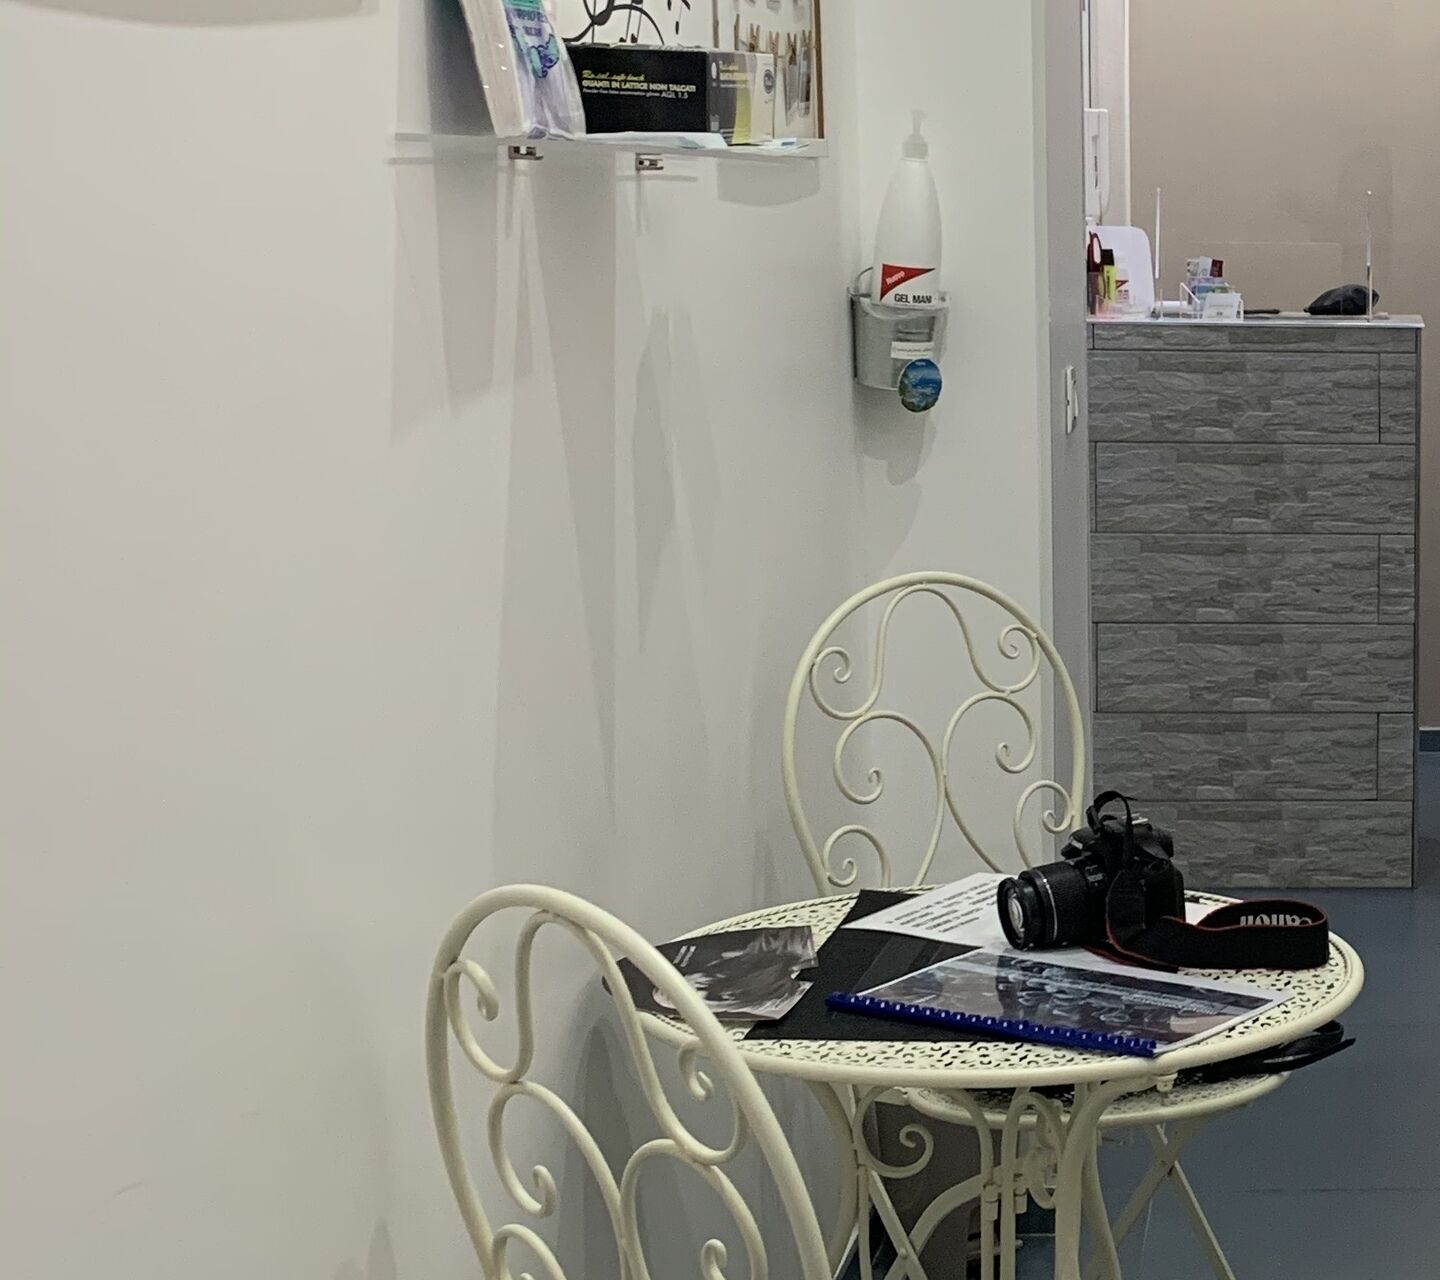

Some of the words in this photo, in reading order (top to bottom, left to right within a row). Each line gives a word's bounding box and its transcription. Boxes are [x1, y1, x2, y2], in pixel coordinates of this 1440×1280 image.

[582, 80, 610, 88] GUANTI
[611, 81, 620, 89] IN
[621, 81, 648, 90] LATTICE
[649, 83, 667, 91] NON
[669, 84, 697, 93] TALCATI
[661, 91, 676, 99] AQL
[894, 293, 910, 304] GEL
